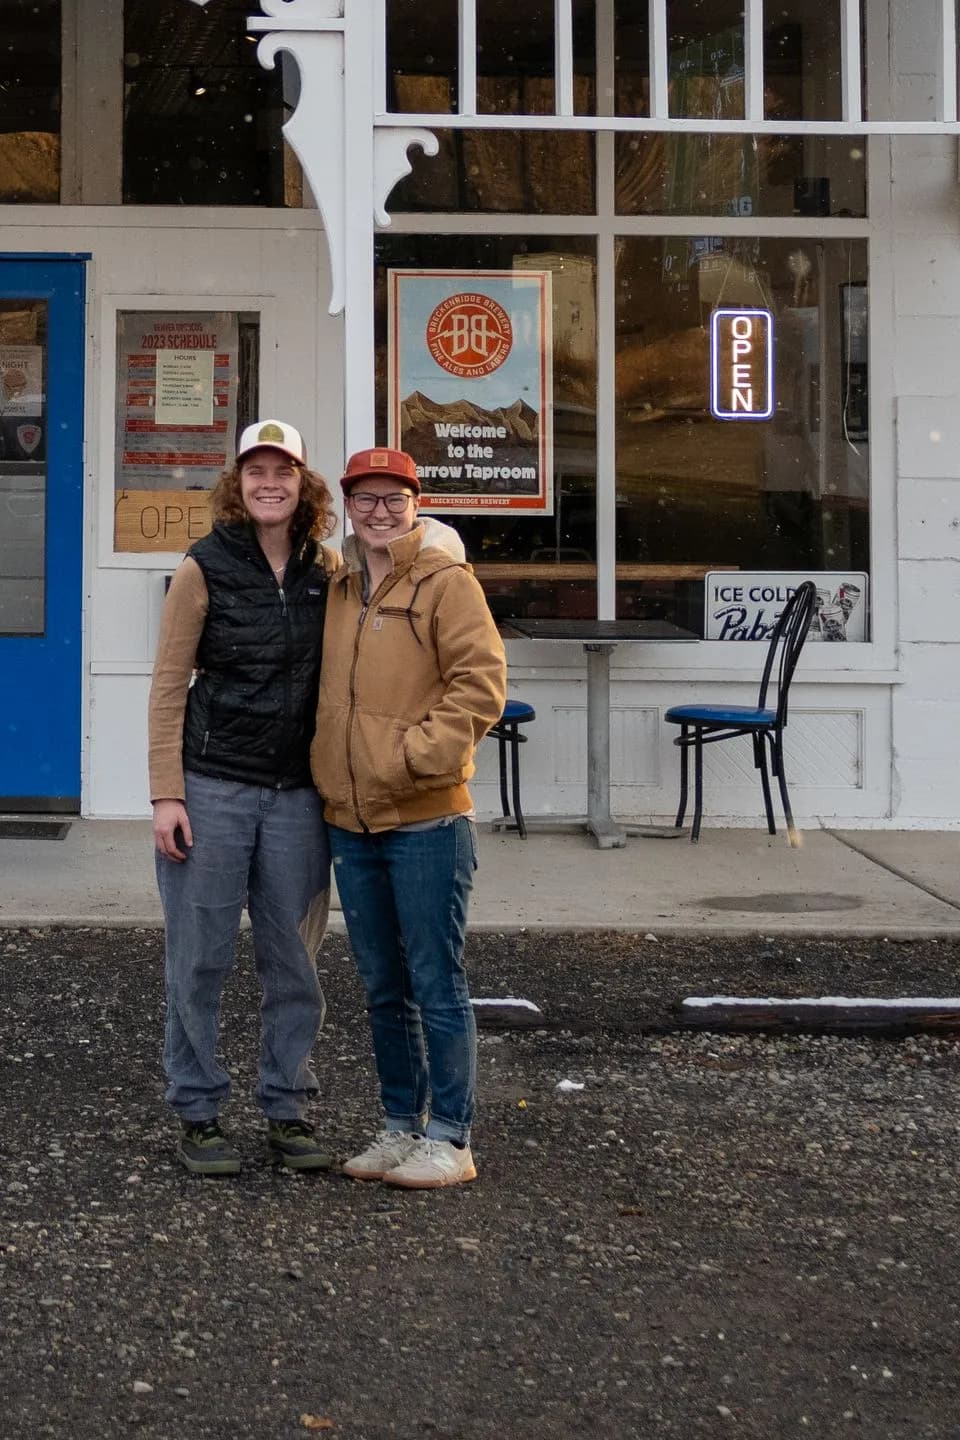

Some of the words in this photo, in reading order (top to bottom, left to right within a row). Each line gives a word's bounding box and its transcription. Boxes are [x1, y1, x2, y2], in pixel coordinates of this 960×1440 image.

[429, 295, 481, 333] BRECKENRIDGE
[484, 299, 511, 335] BREWERY
[142, 334, 166, 349] 2023
[167, 334, 217, 349] SCHEDULE
[430, 342, 444, 362] FINE
[442, 360, 464, 375] ALES
[466, 367, 485, 376] AND
[486, 343, 510, 371] LAGERS
[731, 316, 753, 412] OPEN
[434, 423, 507, 439] Welcome
[447, 444, 465, 458] to
[467, 444, 494, 459] the
[415, 464, 462, 479] arrow
[464, 464, 536, 480] Taproom
[139, 505, 208, 540] OPE
[714, 586, 743, 602] ICE
